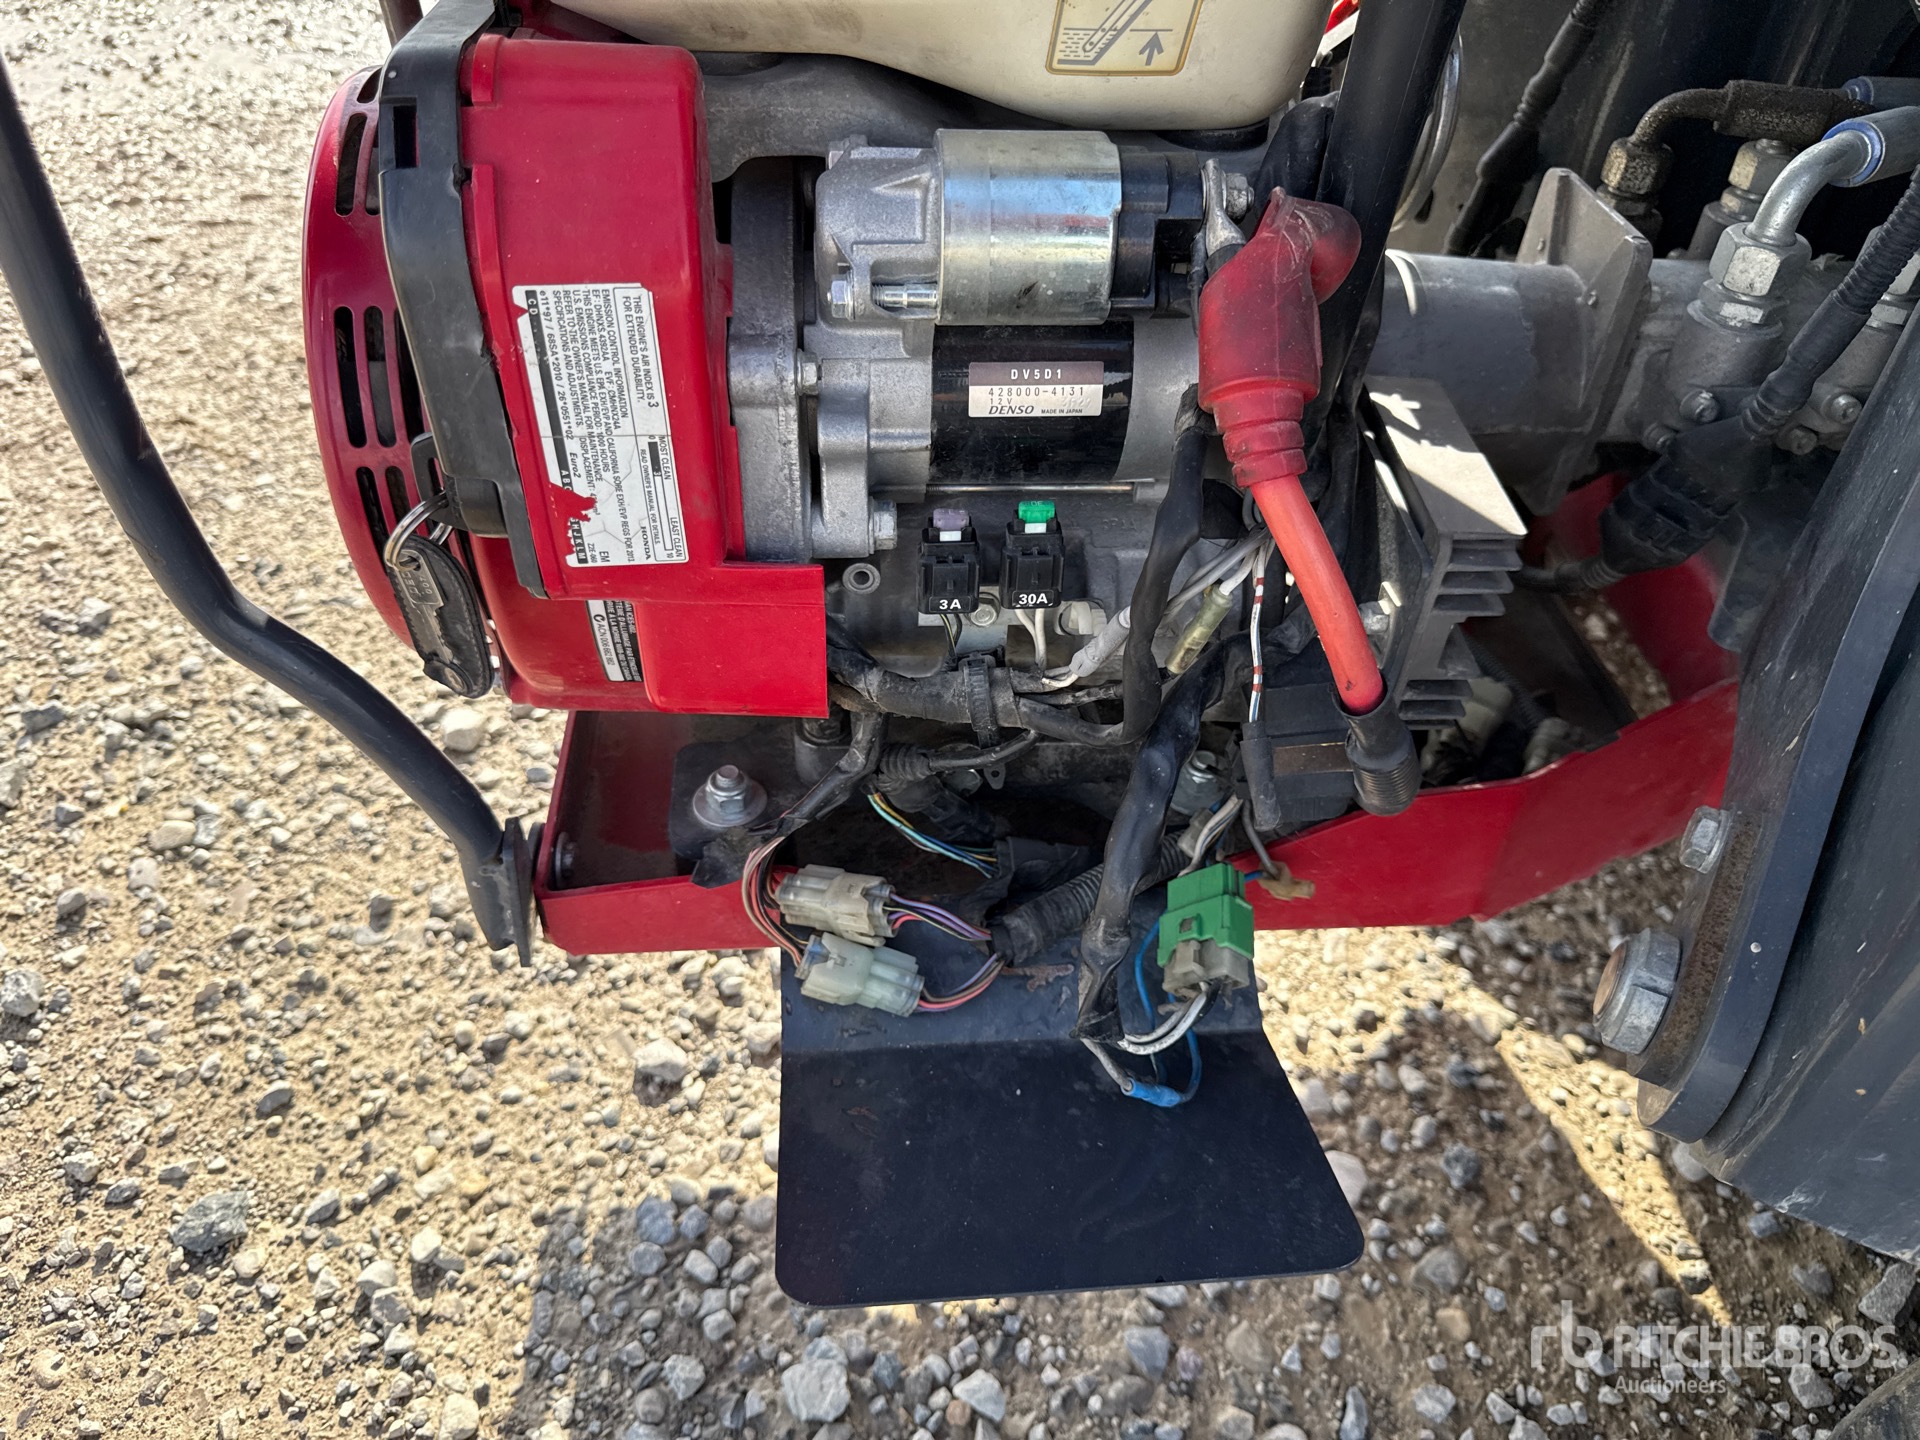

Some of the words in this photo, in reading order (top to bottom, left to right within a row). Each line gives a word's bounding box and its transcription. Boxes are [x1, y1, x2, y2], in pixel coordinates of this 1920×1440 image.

[563, 290, 574, 315] REFER
[572, 290, 582, 304] U.S.
[582, 289, 592, 306] THIS
[622, 296, 632, 312] FOR
[633, 296, 642, 314] THIS
[602, 289, 614, 328] EMISSION
[552, 290, 570, 352] SPECIFICATIONS
[566, 317, 577, 328] TO
[574, 307, 590, 351] EMISSIONS
[584, 308, 596, 336] ENGINE
[569, 330, 579, 344] THE
[625, 314, 638, 355] EXTENDED
[636, 316, 648, 352] ENGINE'S
[590, 337, 601, 361] MEETS
[608, 330, 620, 366] CONTROL
[563, 354, 573, 370] AND
[572, 346, 586, 380] OWNER'S
[593, 363, 603, 376] U.S.
[641, 354, 650, 366] AIR
[582, 352, 598, 400] COMPLIANCE
[596, 378, 606, 390] EPA
[631, 358, 645, 402] DURABILITY.
[643, 369, 653, 391] INDEX
[1011, 369, 1061, 379] DV5D1
[564, 372, 584, 428] ADJUSTMENTS.
[578, 382, 590, 414] MANUAL
[613, 368, 628, 418] INFORMATION
[989, 387, 1084, 396] 428000-4131
[591, 402, 602, 430] PERIOD:
[598, 392, 610, 421] EXH/EVP
[607, 390, 621, 430] CMHNX24A
[988, 406, 1034, 414] DENSO
[586, 416, 594, 430] FOR
[604, 422, 614, 436] AND
[596, 432, 605, 447] 1000
[659, 437, 668, 456] MOST
[569, 452, 581, 478] Euro2
[579, 437, 596, 492] DISPLACEMENT:
[587, 431, 603, 482] MAINTENANCE
[600, 449, 610, 473] HOURS
[606, 437, 620, 475] CALIFORNIA
[640, 449, 650, 463] READ
[642, 465, 652, 489] OWNER'S
[662, 458, 671, 480] CLEAN
[612, 476, 623, 493] SORE
[616, 494, 627, 520] EXH/EVP
[647, 490, 655, 512] MANUAL
[621, 521, 630, 536] REGS
[652, 524, 660, 545] DETAILS.
[670, 517, 680, 536] LEAST
[641, 526, 651, 560] HONDA
[674, 537, 683, 558] CLEAN
[599, 551, 610, 563] EM
[939, 599, 961, 610] 3A
[1019, 593, 1048, 605] 30A
